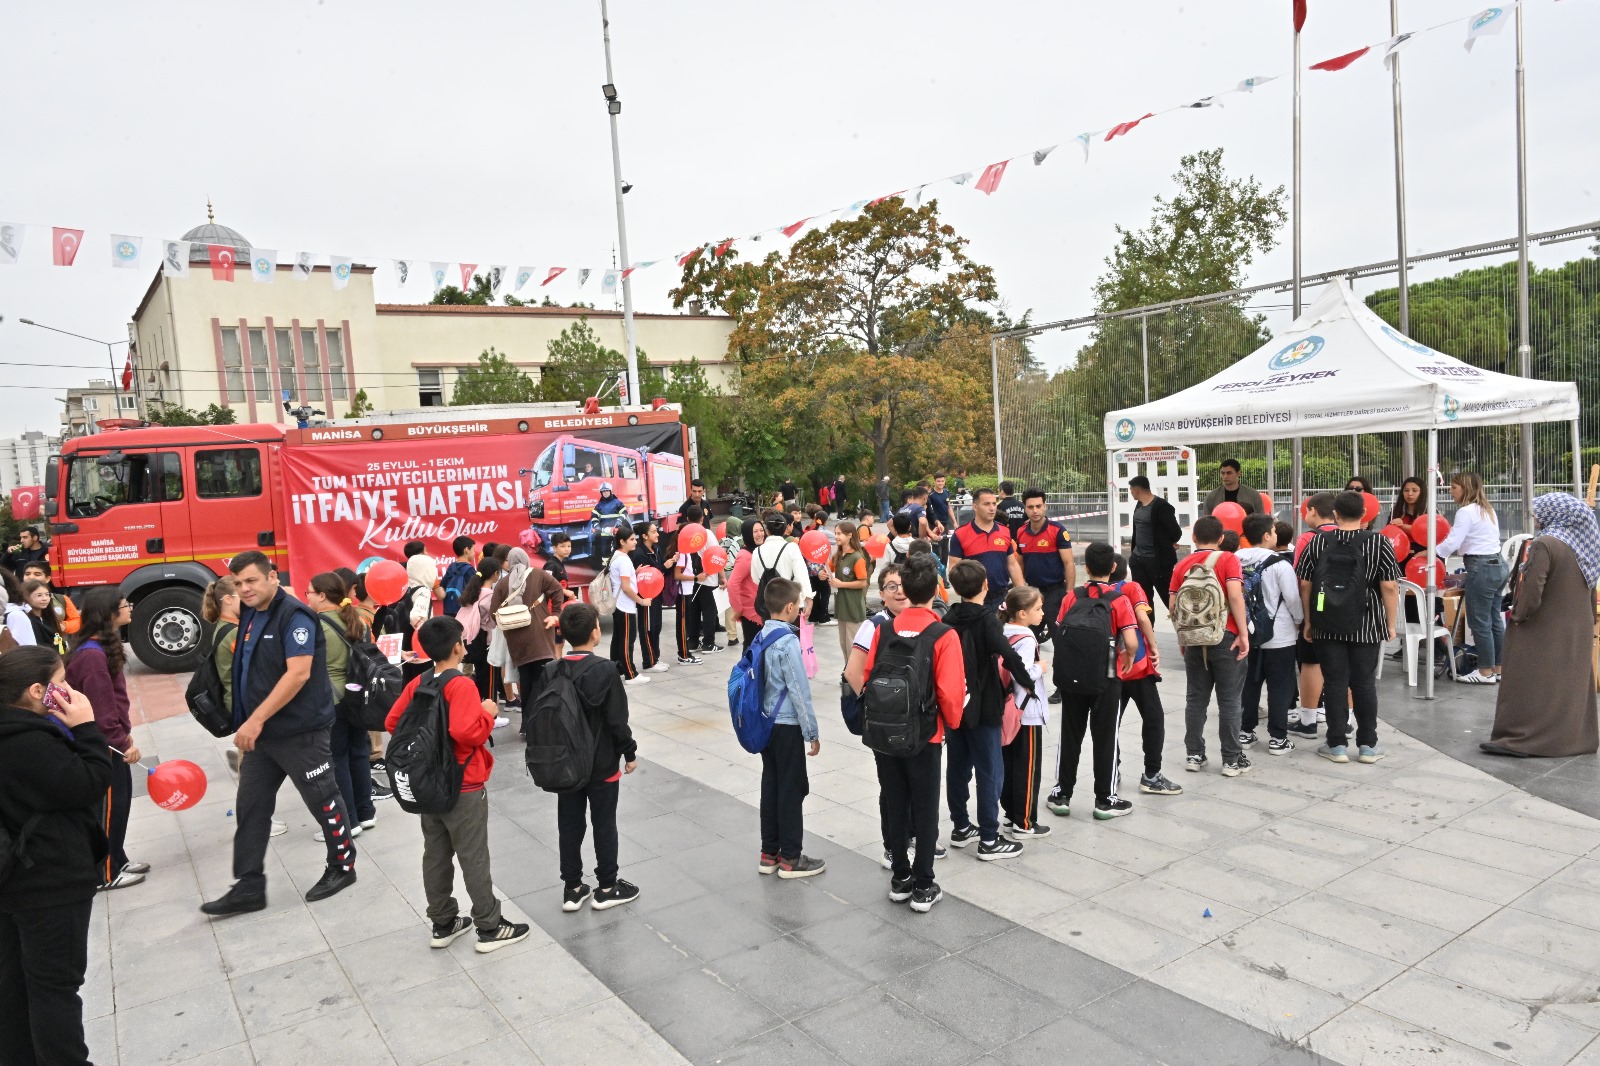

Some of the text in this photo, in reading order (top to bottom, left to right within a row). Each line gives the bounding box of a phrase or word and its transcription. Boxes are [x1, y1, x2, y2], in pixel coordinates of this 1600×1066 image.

[1264, 369, 1341, 386] ZEYREK
[312, 415, 613, 441] MANİSA BÜYÜKŞEHİR BELEDİYESİ
[1143, 410, 1291, 432] MANİSA BÜYÜKŞEHİR BELEDİYESİ
[367, 462, 380, 471] 25
[382, 460, 419, 470] EYLÜL
[428, 459, 434, 467] 1
[311, 475, 347, 490] TÜM
[291, 480, 523, 525] İTFAİYE HAFTASI
[358, 514, 498, 550] Kutlu Olsun
[68, 544, 137, 556] BÜYÜKŞEHİR BELEDİYESİ
[91, 539, 114, 547] MANİSA
[88, 554, 107, 562] DAİRESİ
[108, 553, 138, 562] BAŞKANLIĞI
[306, 761, 330, 780] İTFAİYE
